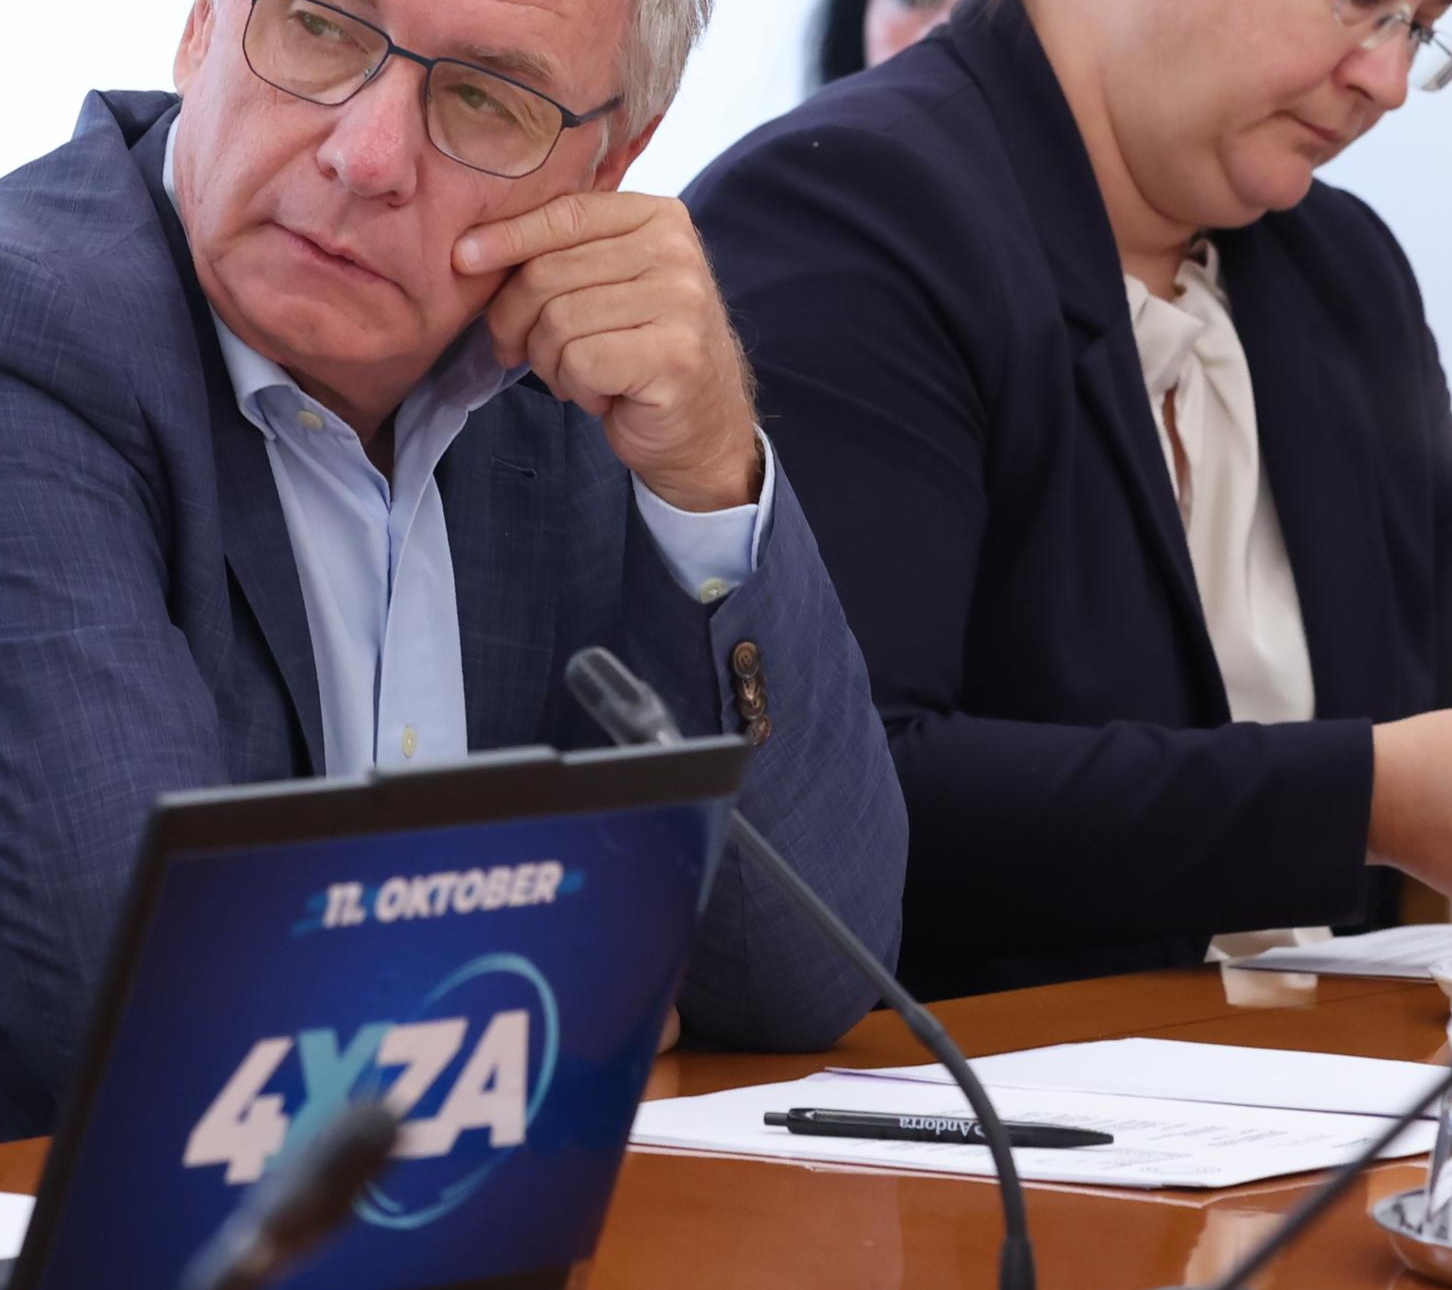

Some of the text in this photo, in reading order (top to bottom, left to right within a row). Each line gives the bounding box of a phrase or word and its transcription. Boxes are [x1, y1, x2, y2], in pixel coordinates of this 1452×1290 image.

[323, 862, 564, 929] 11. OKTOBER
[899, 1116, 973, 1137] Andorra
